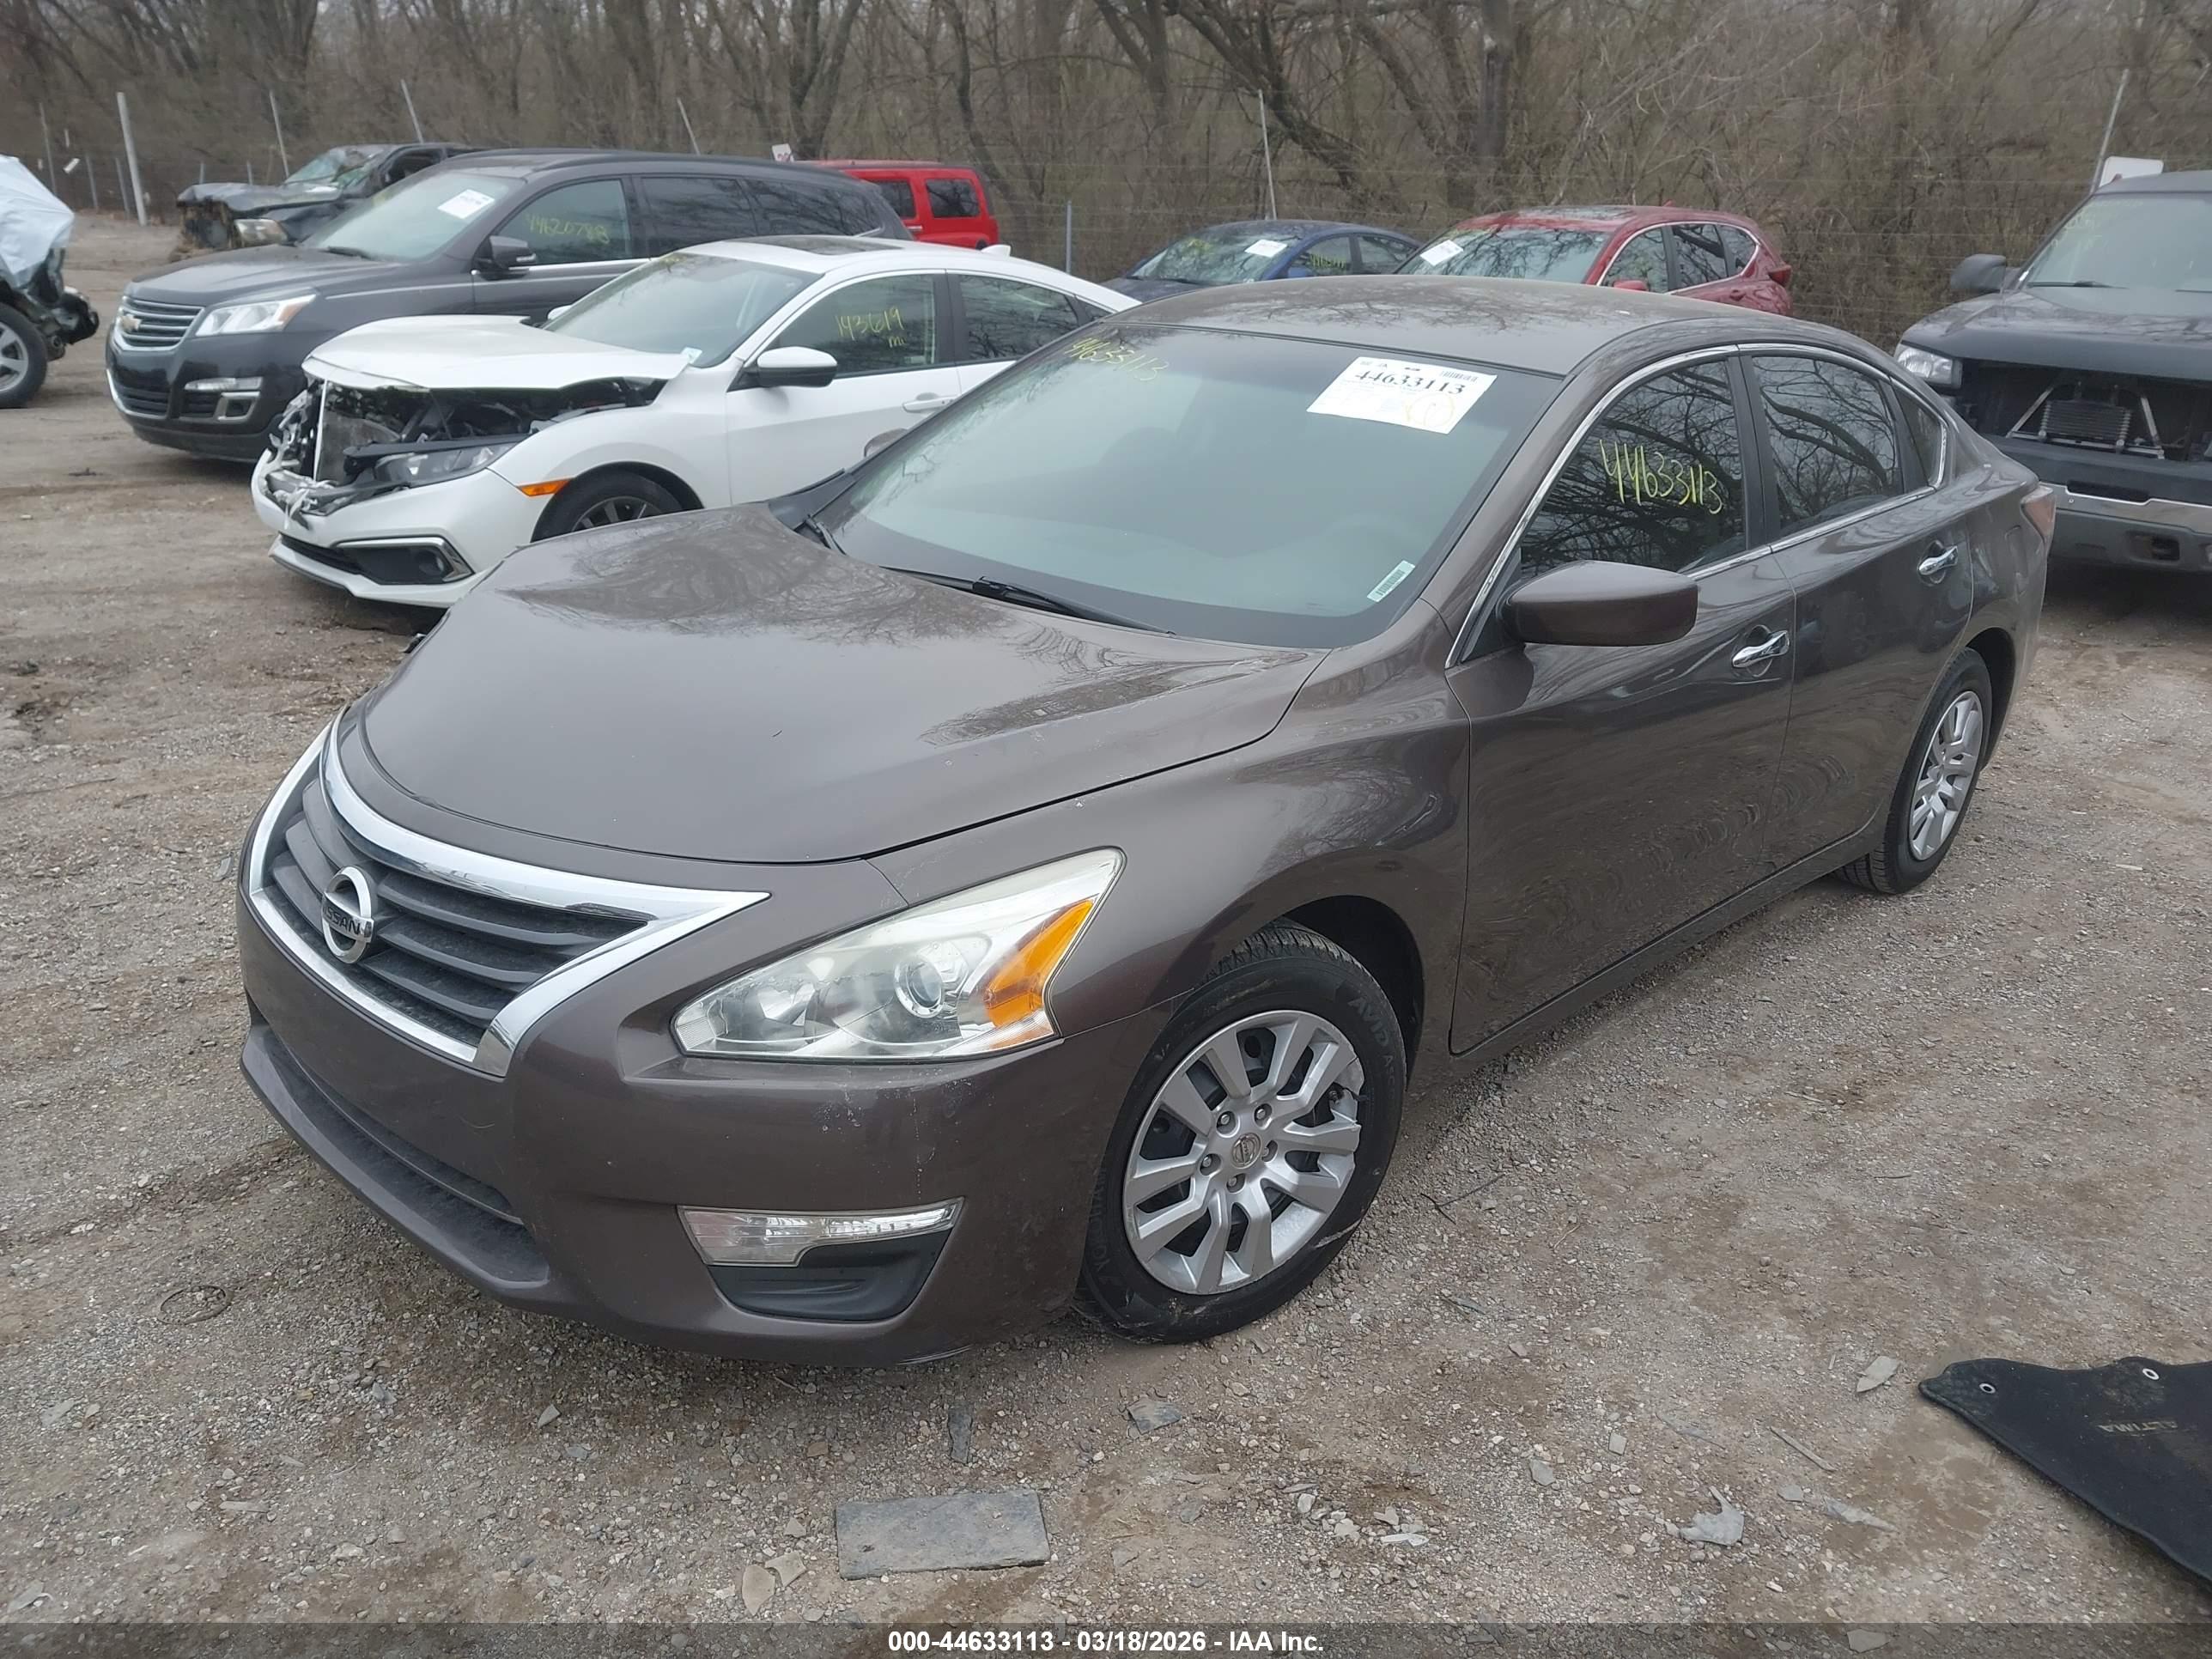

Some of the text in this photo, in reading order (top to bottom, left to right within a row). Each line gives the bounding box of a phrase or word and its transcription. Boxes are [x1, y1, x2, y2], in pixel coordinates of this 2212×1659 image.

[835, 305, 905, 341] 143619
[1354, 369, 1466, 395] 44633113
[1599, 439, 1723, 514] 44633113
